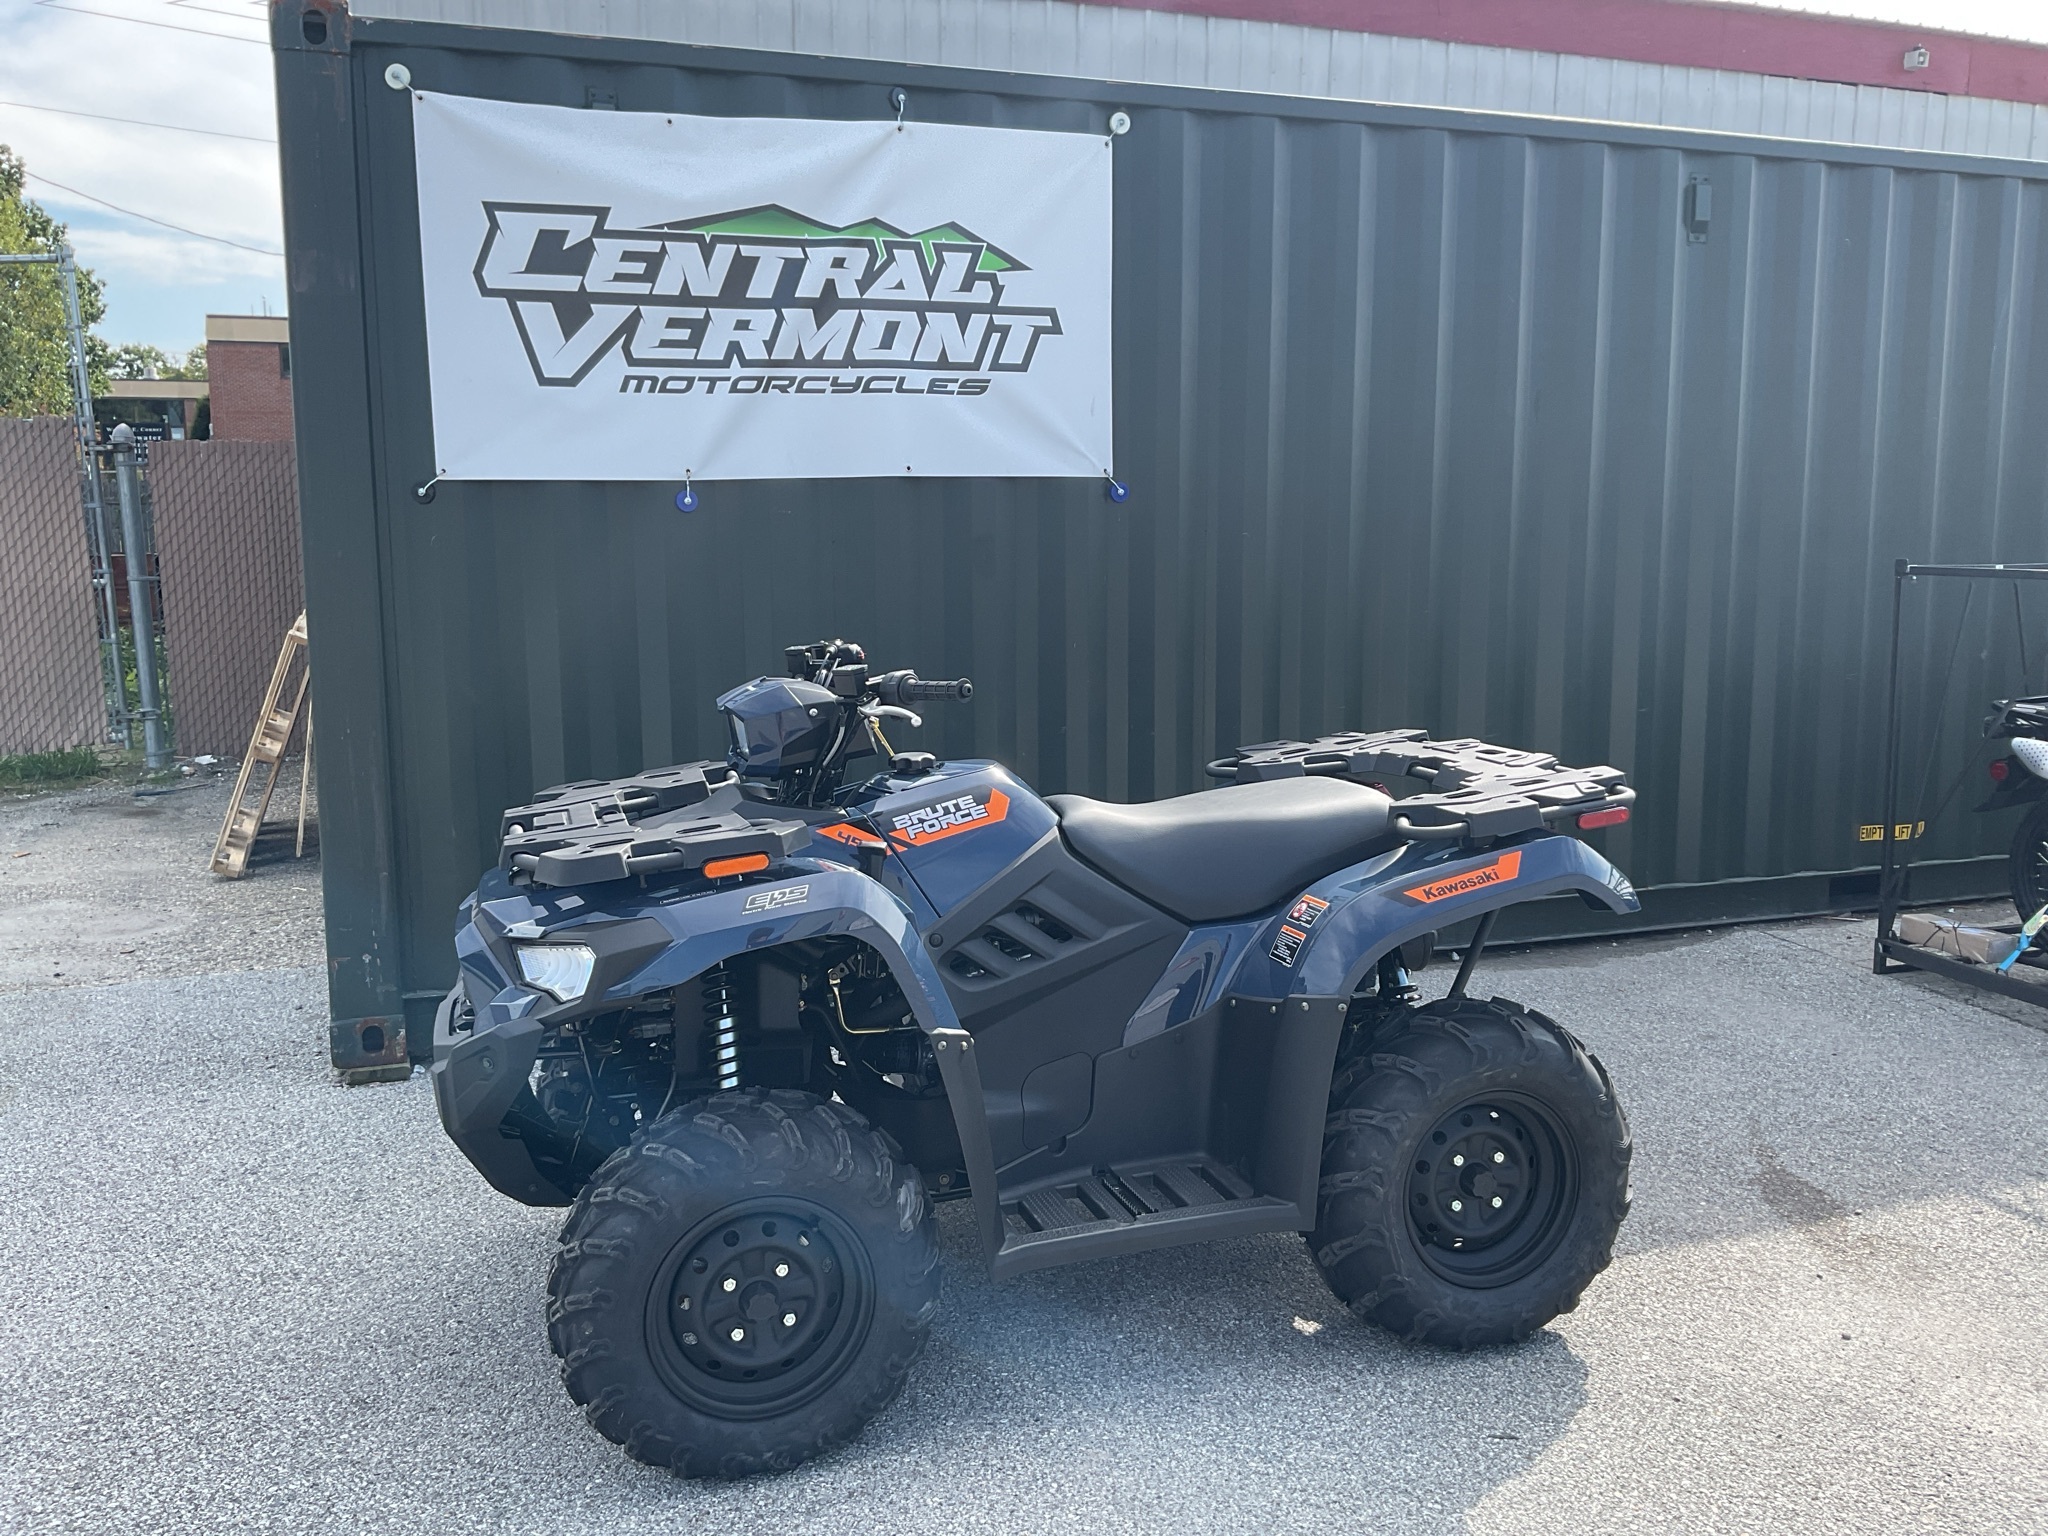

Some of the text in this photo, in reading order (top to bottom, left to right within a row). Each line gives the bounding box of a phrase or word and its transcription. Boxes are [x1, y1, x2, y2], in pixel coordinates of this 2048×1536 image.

[479, 204, 1001, 303] CENTRAL
[510, 298, 1060, 384] VERMONT
[619, 373, 992, 396] MOTORCYCLES
[892, 794, 977, 829] BRUTE
[906, 804, 990, 840] FORCE
[837, 830, 863, 846] 45
[1860, 827, 1884, 839] EMPT
[1895, 826, 1911, 839] IFT
[745, 884, 809, 909] EPS
[1422, 868, 1500, 900] Kawasaki
